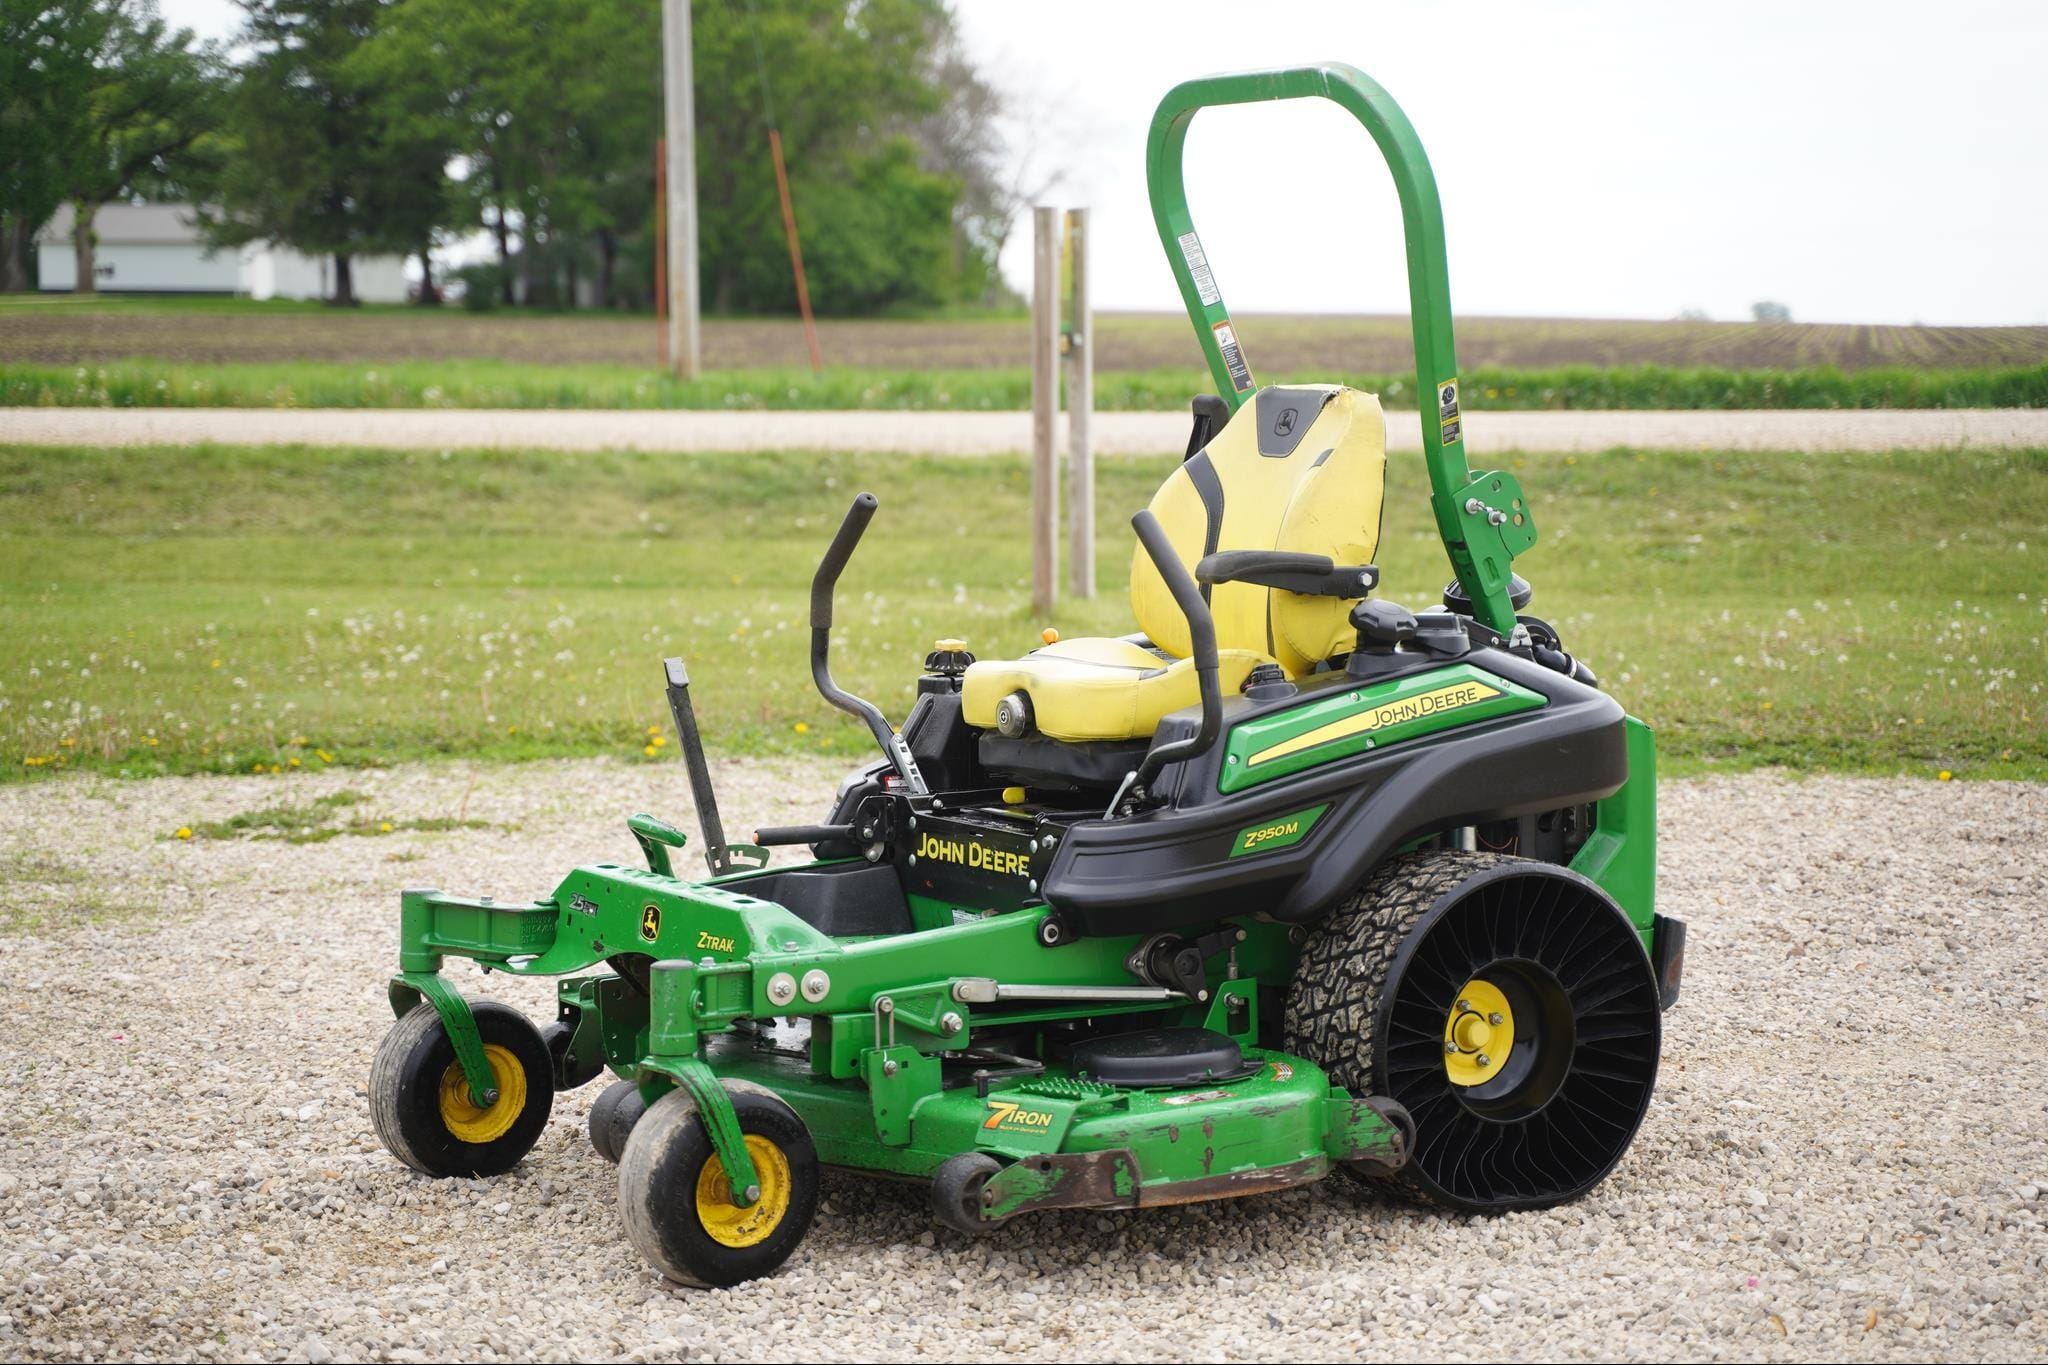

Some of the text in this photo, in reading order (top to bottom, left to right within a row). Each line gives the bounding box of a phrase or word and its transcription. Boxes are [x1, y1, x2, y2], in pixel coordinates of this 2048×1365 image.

[1371, 687, 1478, 728] JOHN DEERE
[1243, 820, 1299, 849] Z950M
[917, 832, 1030, 878] JOHN DEERE
[696, 931, 735, 953] ZTRAK
